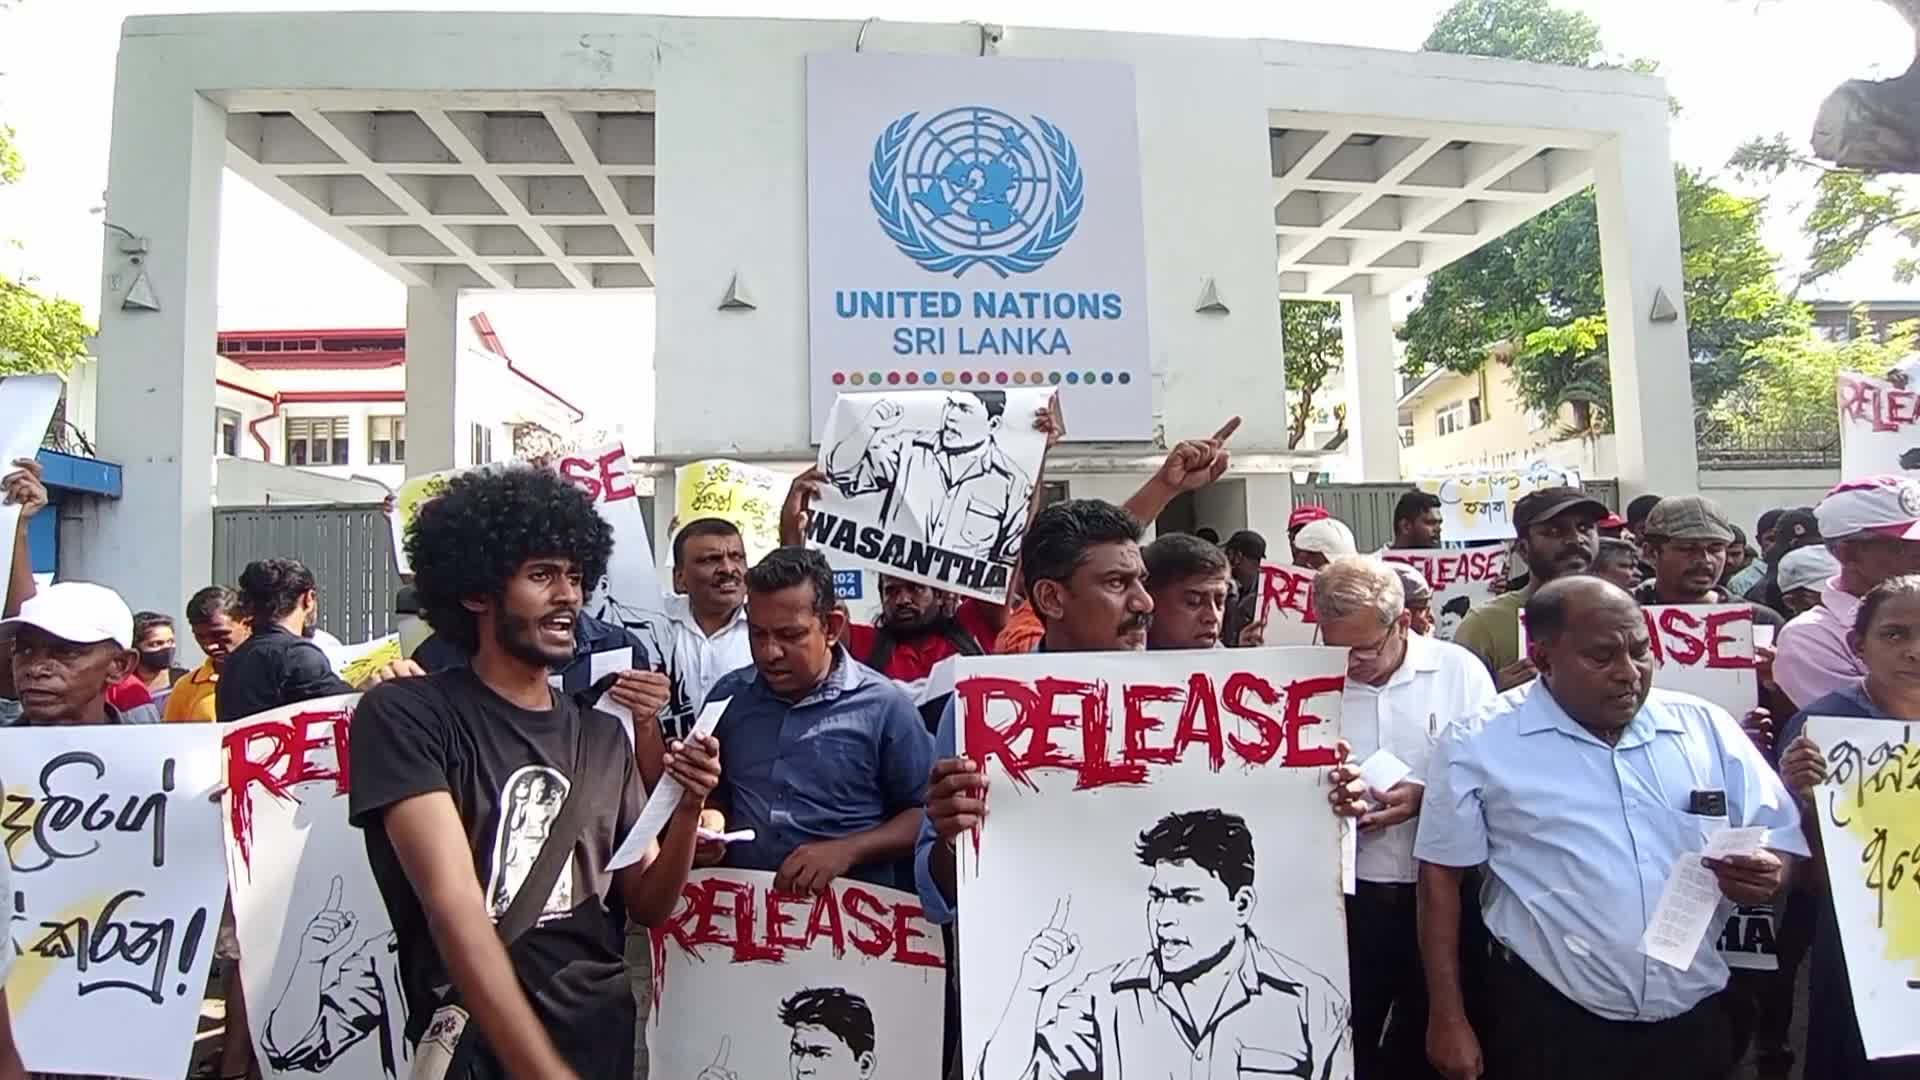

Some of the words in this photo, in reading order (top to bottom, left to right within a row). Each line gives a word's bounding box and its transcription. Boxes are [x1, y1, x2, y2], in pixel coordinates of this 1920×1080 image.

[836, 291, 962, 319] UNITED
[973, 292, 1122, 320] NATIONS
[893, 327, 945, 356] SRI
[958, 327, 1071, 356] LANKA
[807, 509, 1008, 590] WASANTHA
[955, 672, 1346, 815] RELEASE
[648, 875, 945, 990] RELEASE
